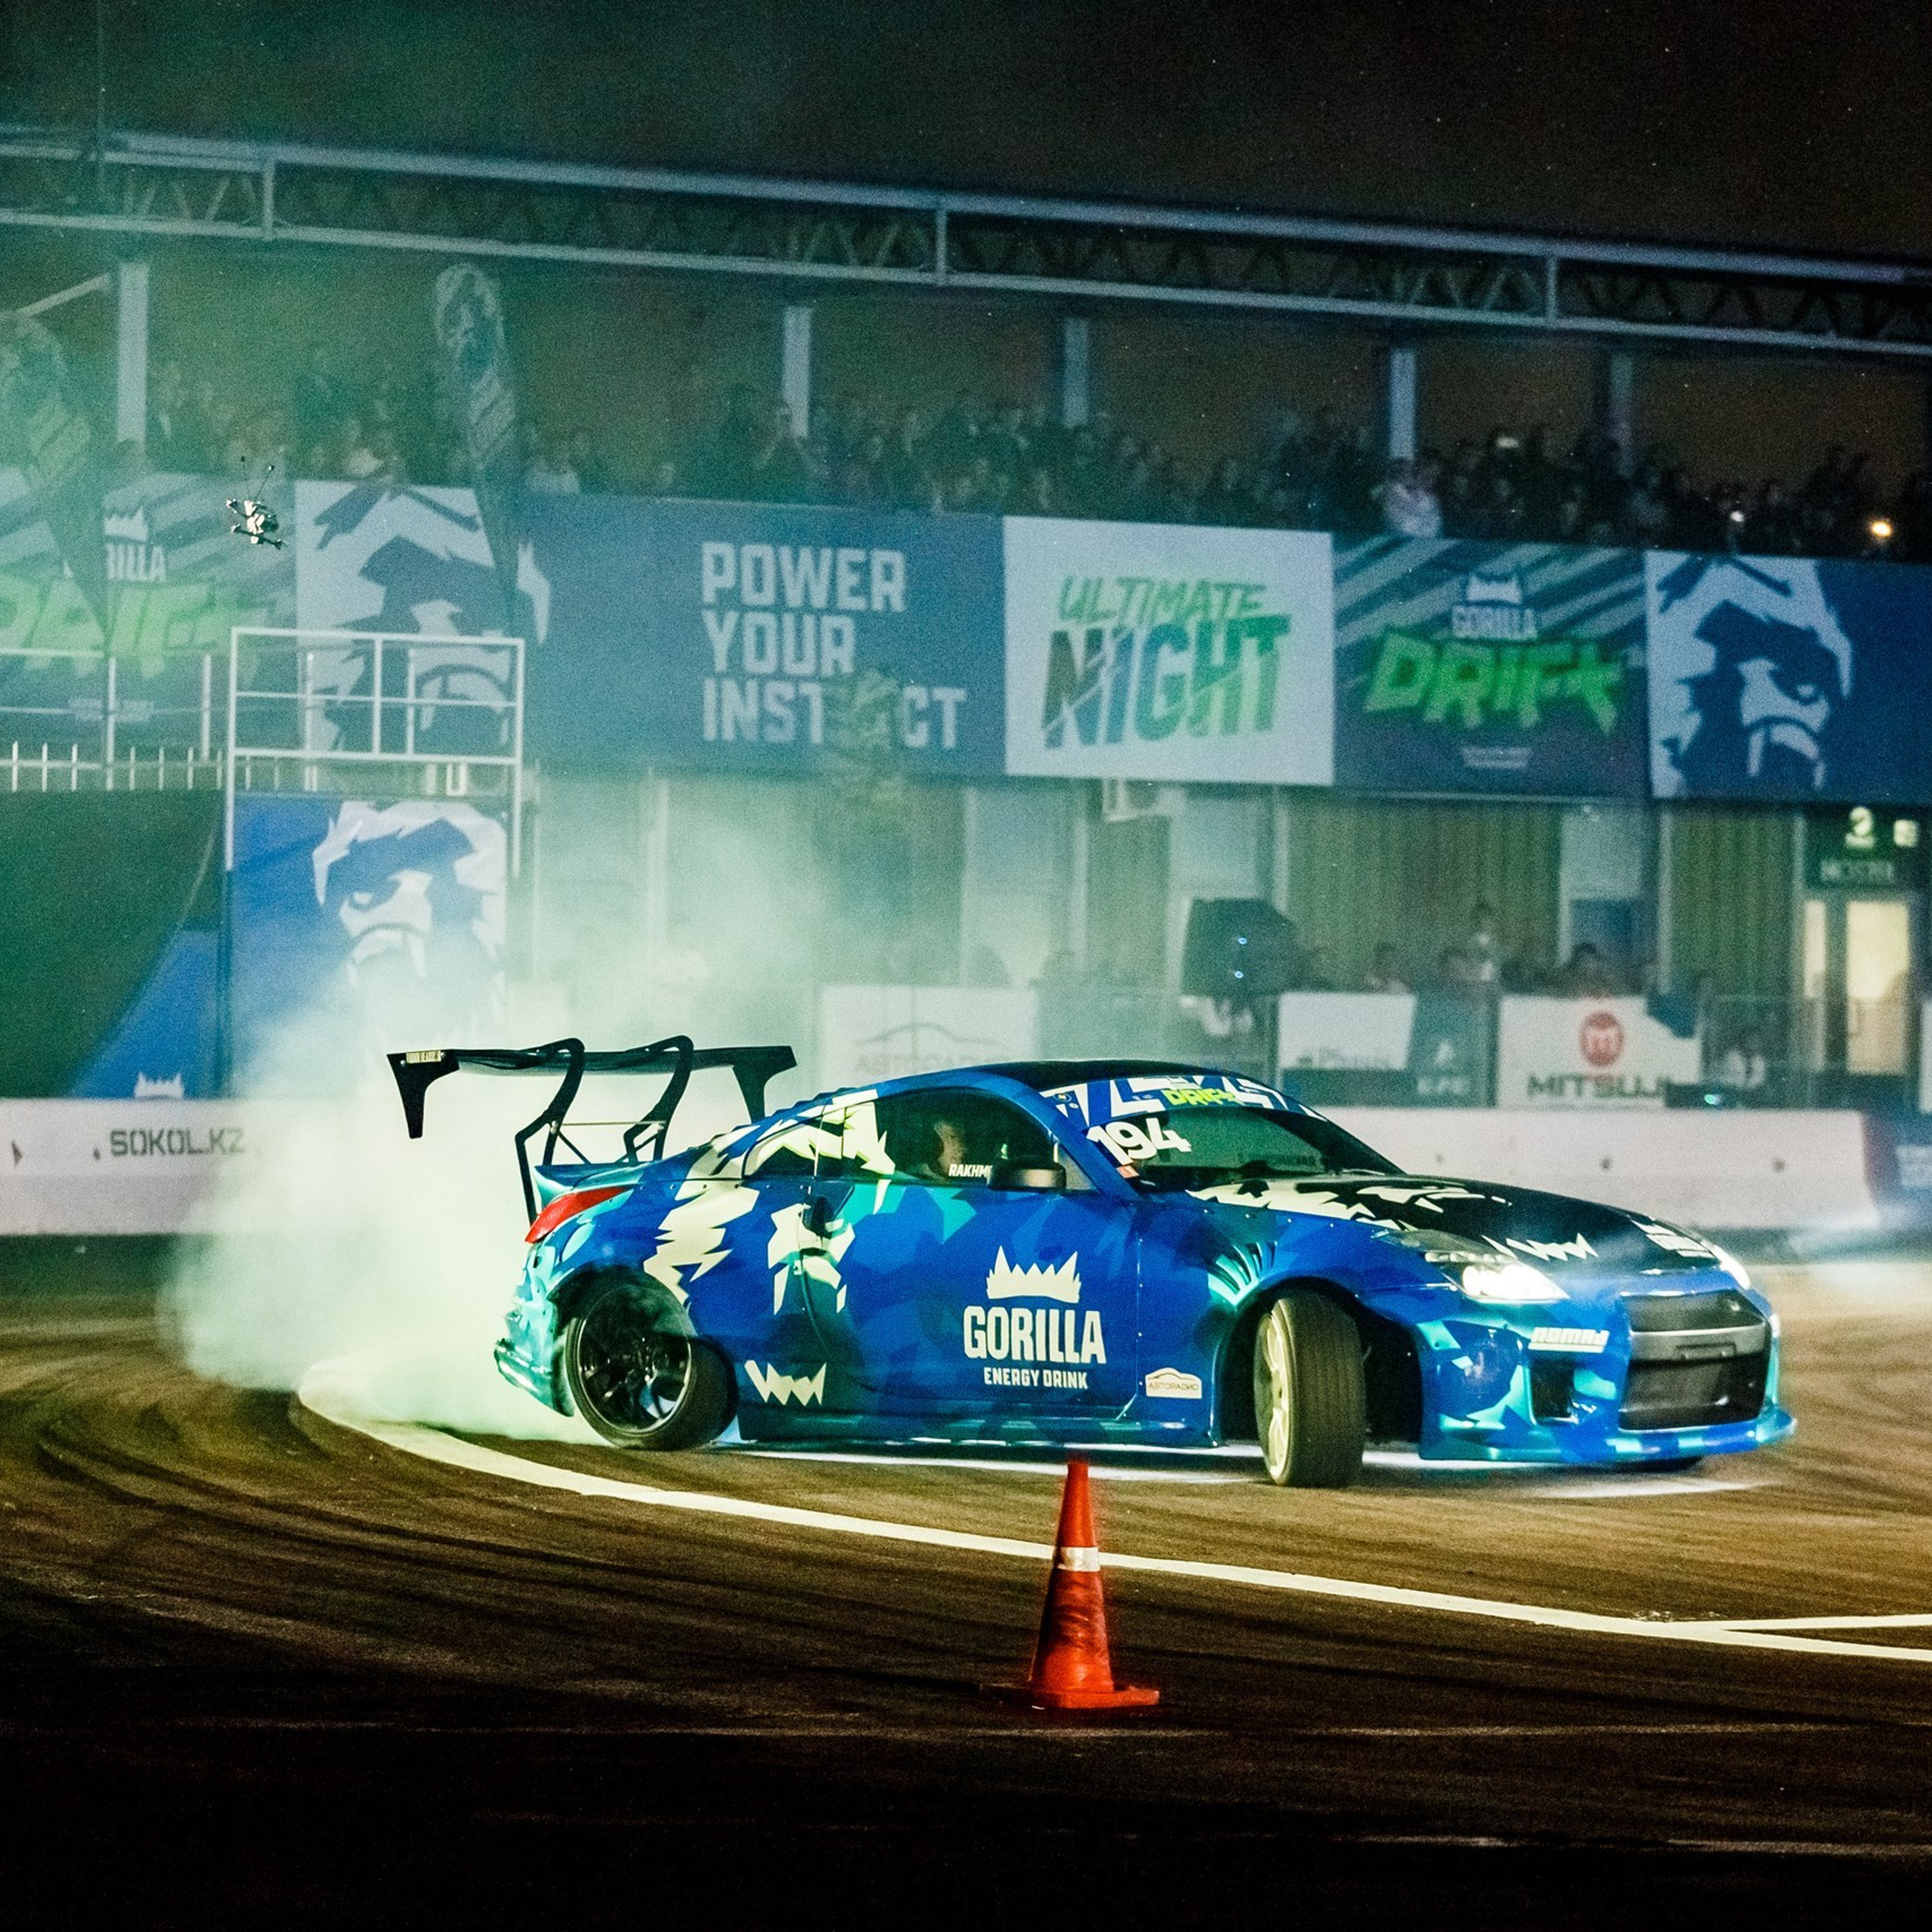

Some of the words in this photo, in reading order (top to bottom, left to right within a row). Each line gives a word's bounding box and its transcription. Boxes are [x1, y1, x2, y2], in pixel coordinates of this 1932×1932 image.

[701, 541, 906, 612] POWER
[1058, 576, 1266, 625] ULTIMATE
[703, 611, 856, 676] YOUR
[1043, 614, 1291, 749] NIGHT
[1364, 631, 1622, 734] DRIFT
[703, 676, 967, 749] INSTCT
[110, 1128, 245, 1158] SOKOL.KZ
[948, 1163, 992, 1178] RAKHM
[1086, 1118, 1192, 1166] 194
[963, 1305, 1107, 1364] GORILLA
[983, 1367, 1039, 1388] ENERGY
[1042, 1369, 1088, 1390] DRINK
